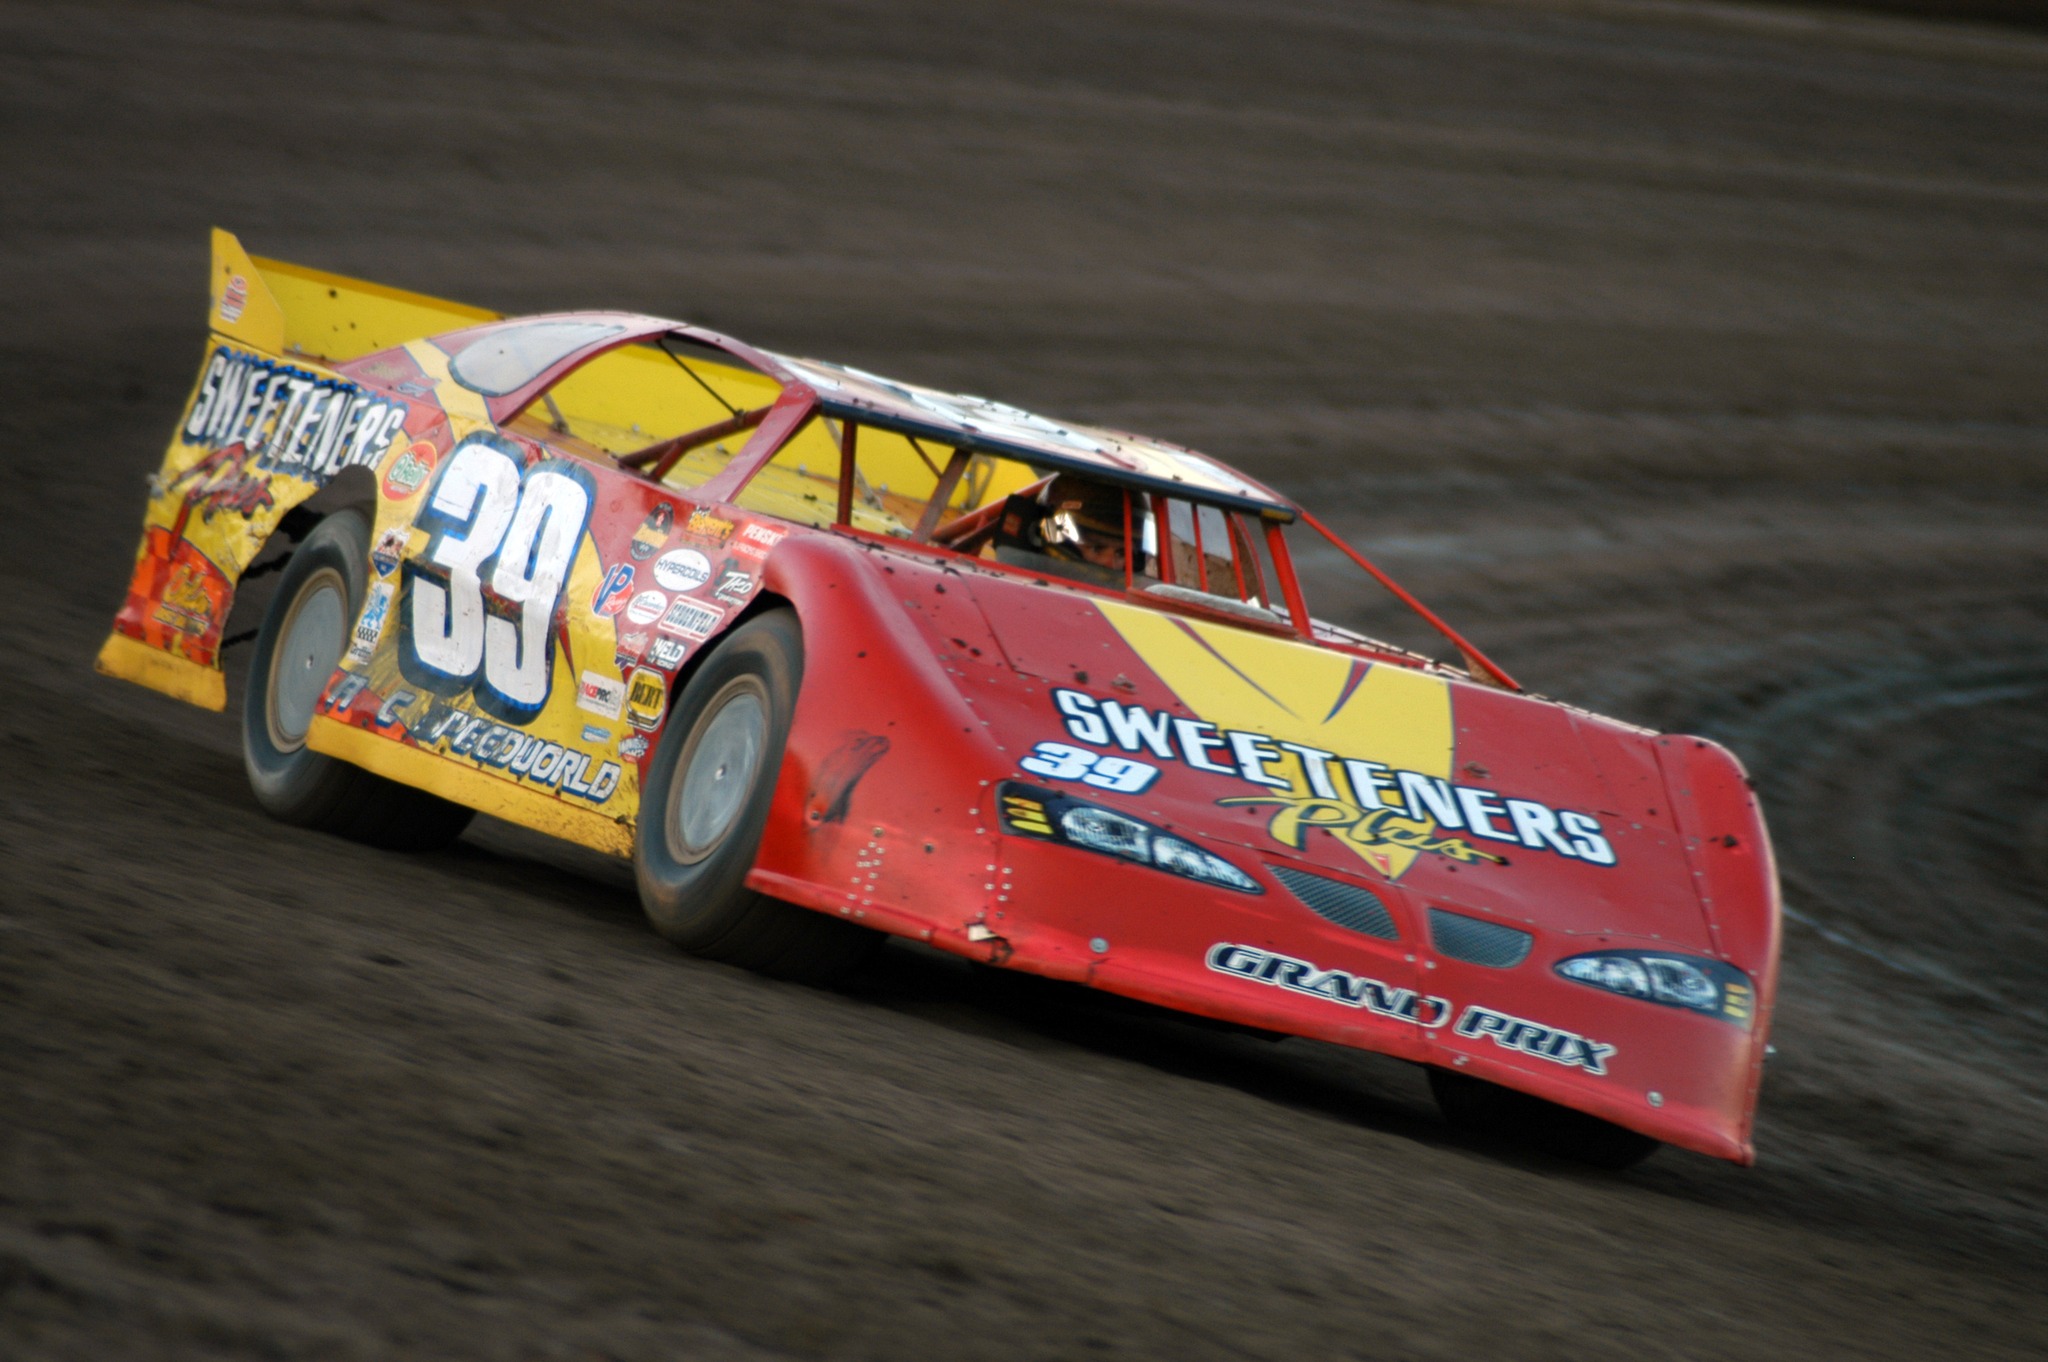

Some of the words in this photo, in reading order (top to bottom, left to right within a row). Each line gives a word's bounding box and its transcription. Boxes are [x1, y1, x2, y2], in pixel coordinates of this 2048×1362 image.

[183, 349, 408, 476] SWEETENERS
[402, 432, 595, 724] 39
[593, 563, 635, 615] VP
[656, 559, 709, 583] HYPERCOILS
[649, 637, 685, 663] WELD
[1020, 741, 1161, 795] 39
[1053, 688, 1617, 867] SWEETENERS
[1216, 796, 1510, 866] Plus
[1205, 941, 1452, 1028] GRAND
[1453, 1005, 1617, 1076] PRIX
